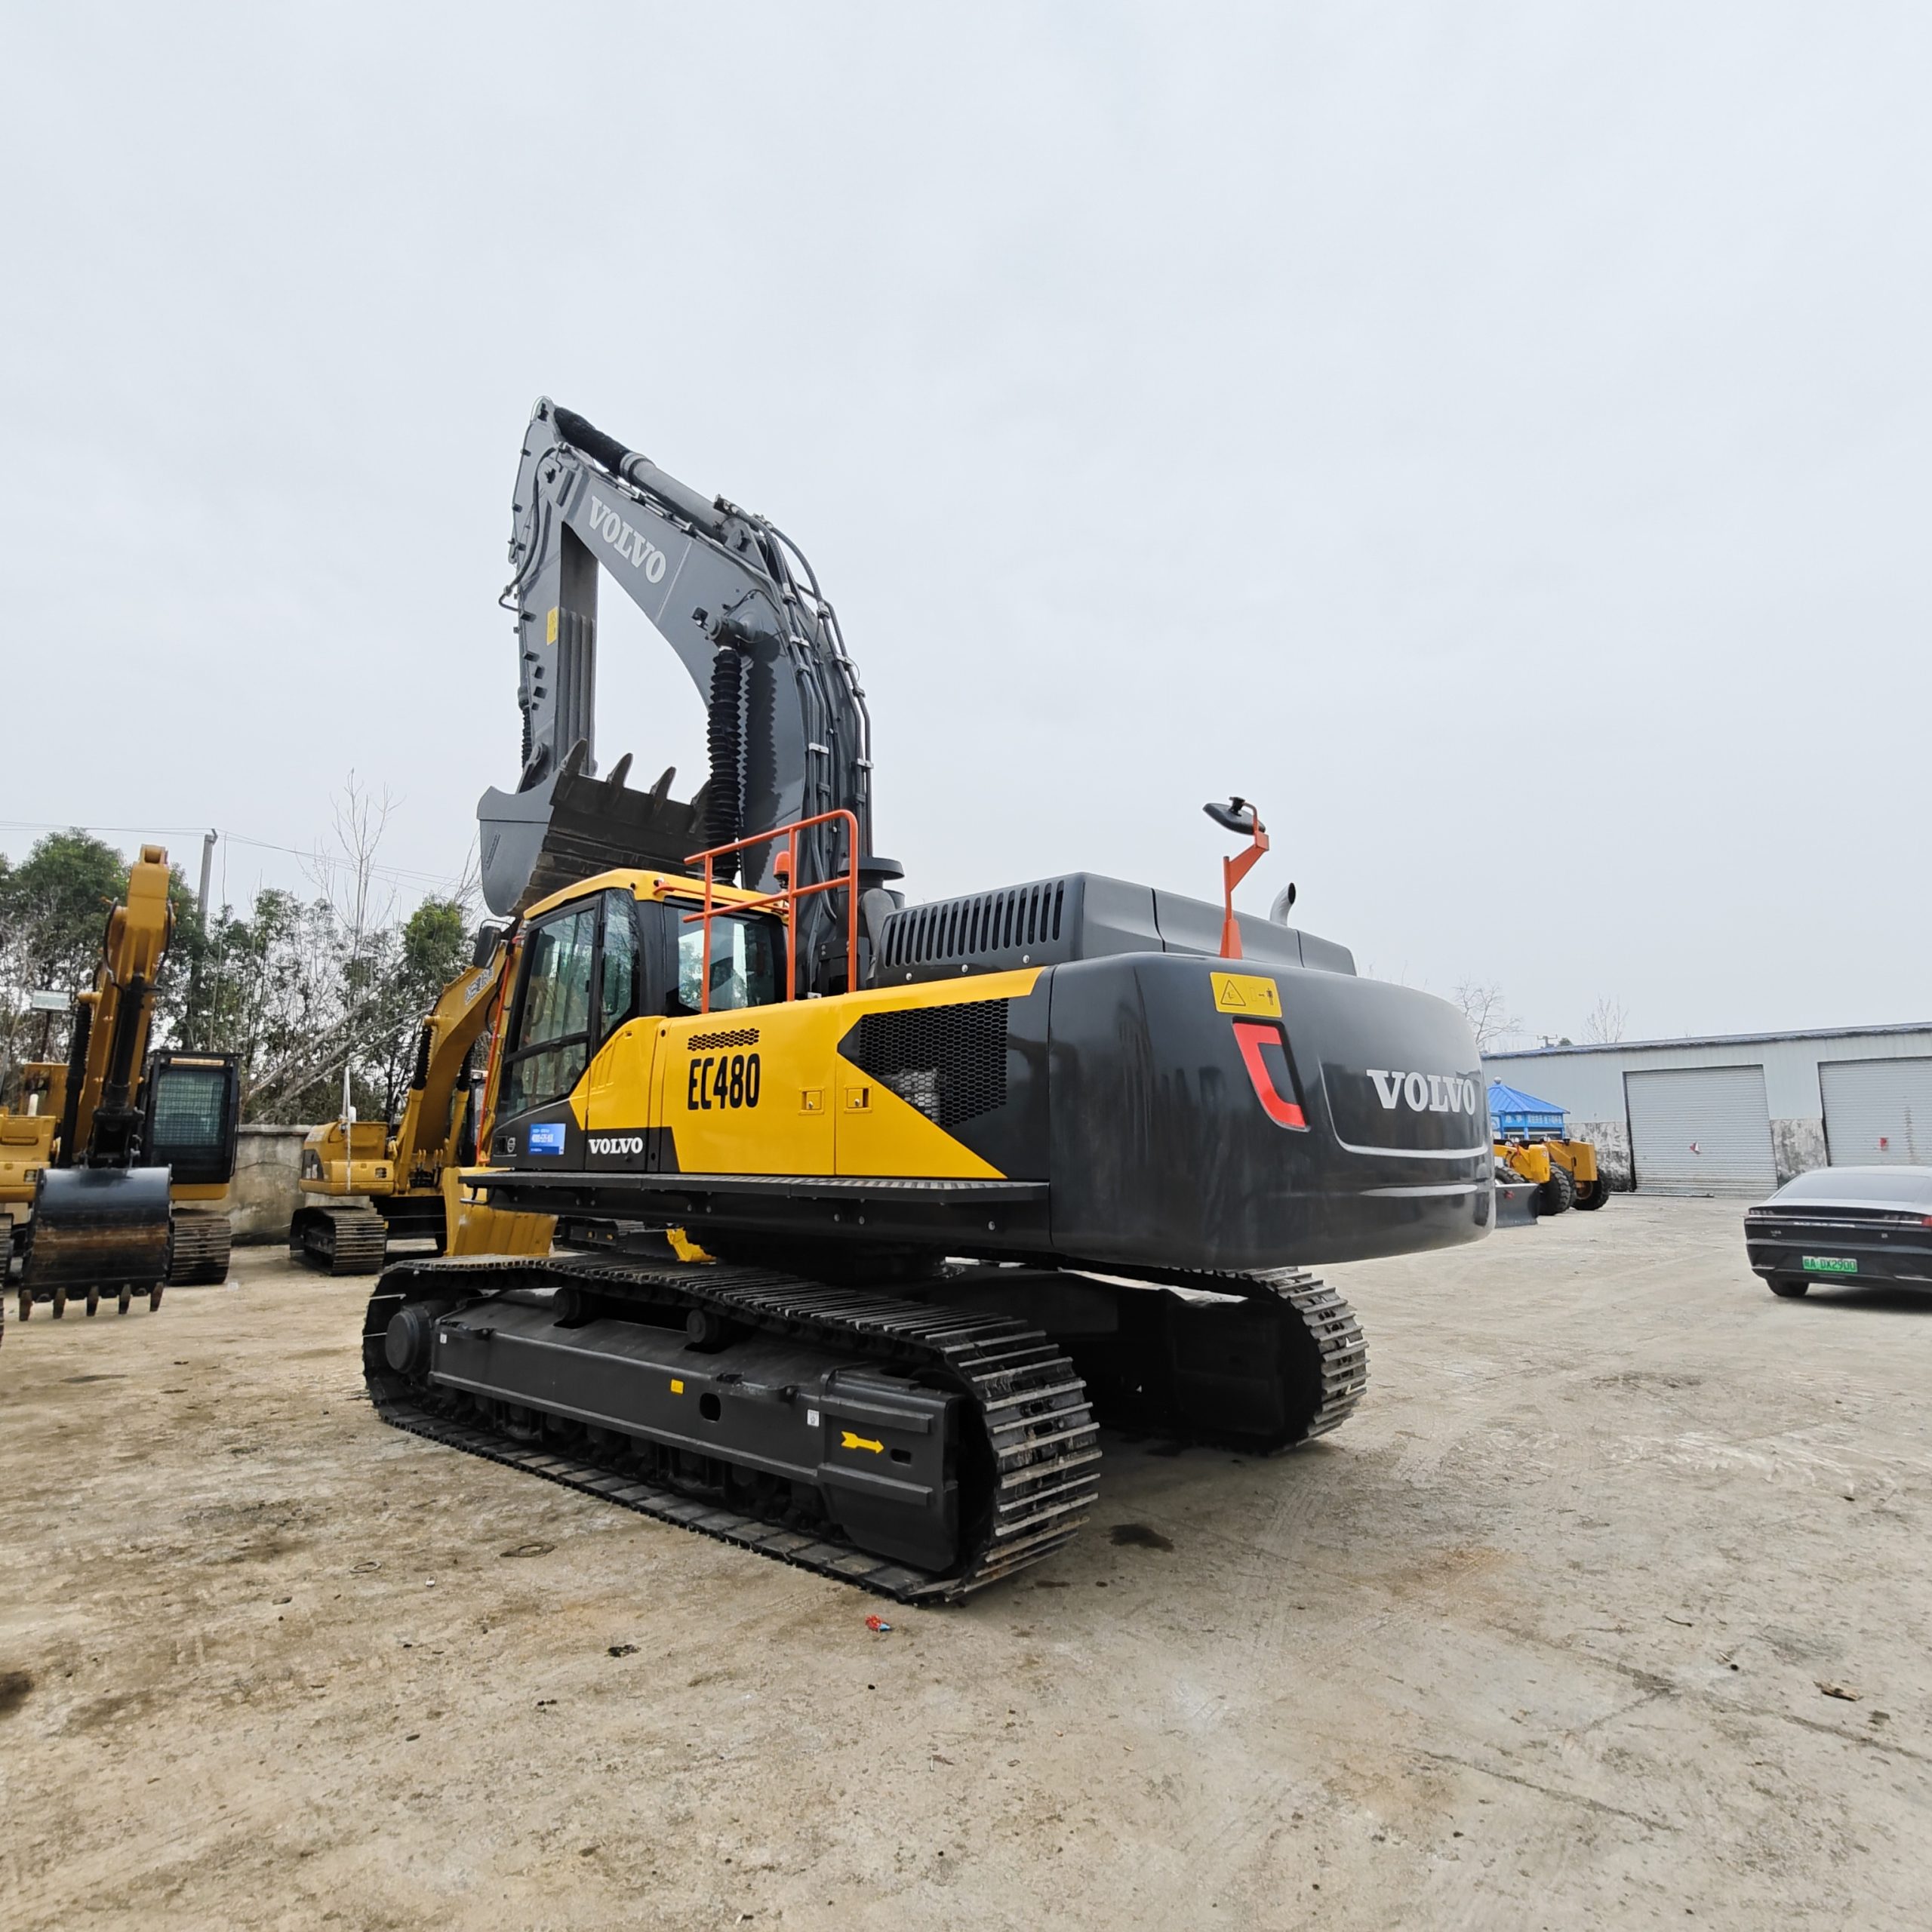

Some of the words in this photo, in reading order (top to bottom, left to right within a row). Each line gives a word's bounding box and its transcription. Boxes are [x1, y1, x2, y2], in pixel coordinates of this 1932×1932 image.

[589, 495, 666, 583] VOLVO
[688, 1053, 761, 1110] EC480
[1366, 1069, 1476, 1115] VOLVO
[588, 1137, 644, 1155] VOLVO
